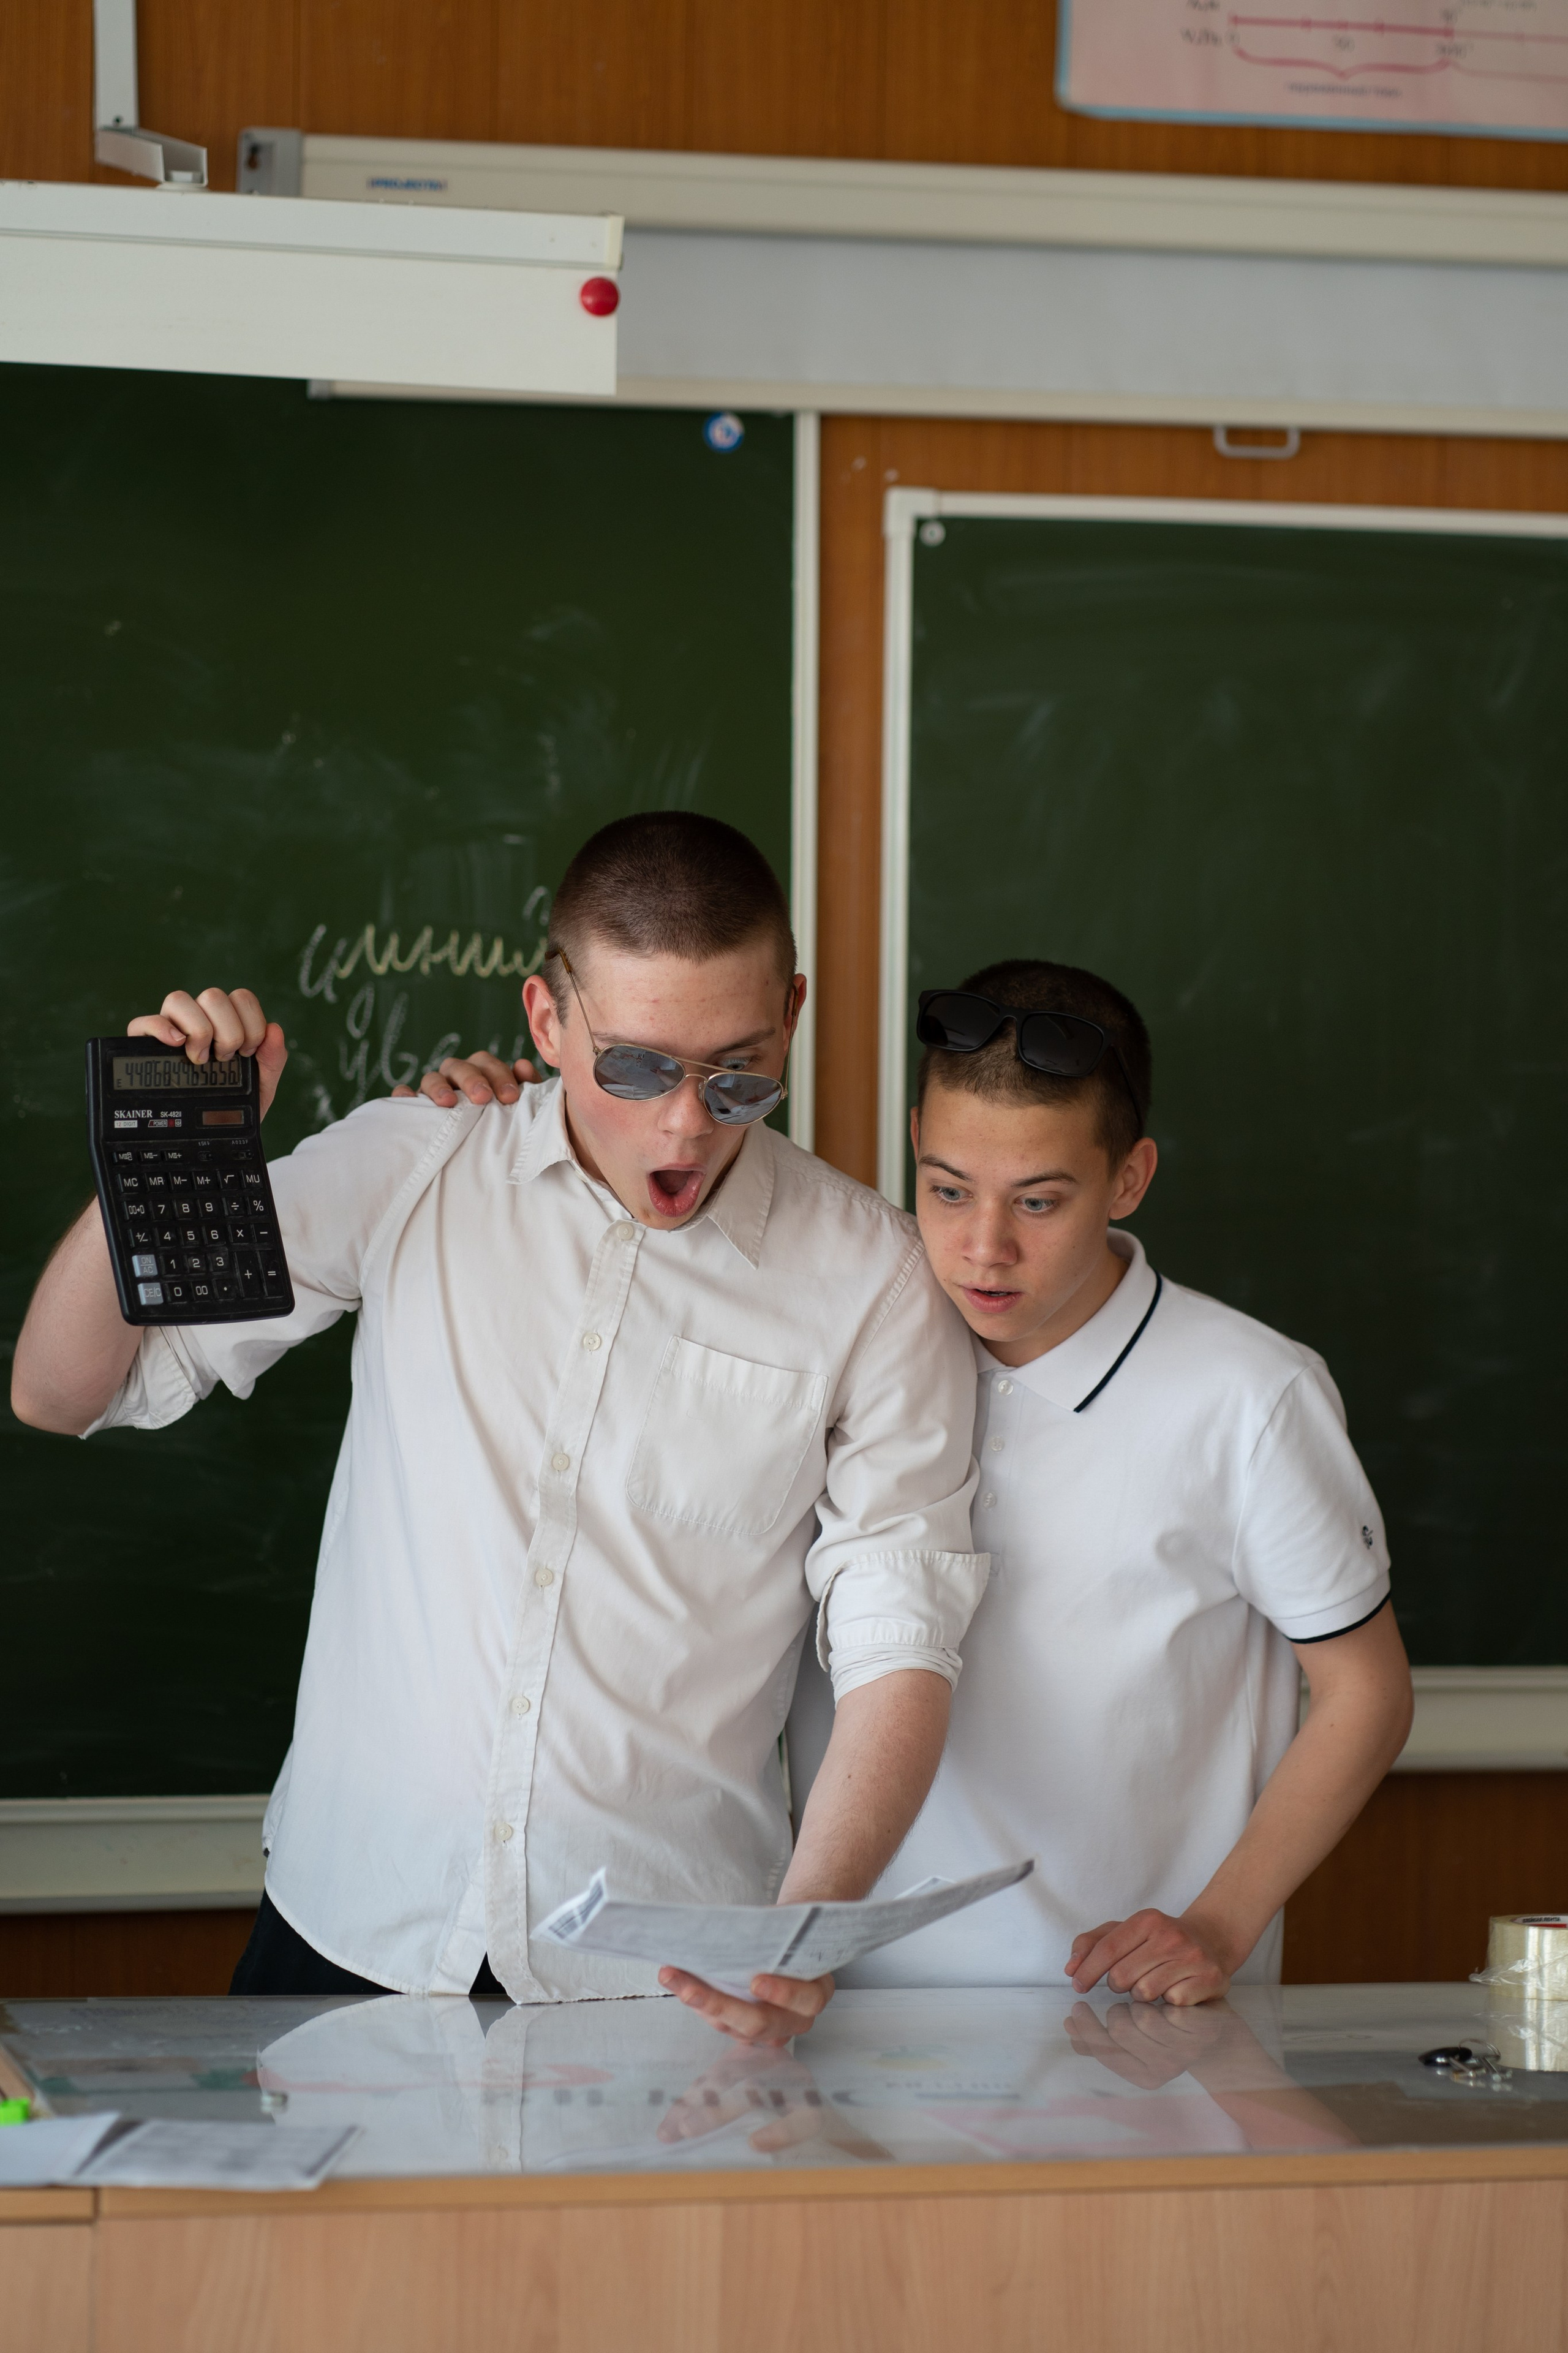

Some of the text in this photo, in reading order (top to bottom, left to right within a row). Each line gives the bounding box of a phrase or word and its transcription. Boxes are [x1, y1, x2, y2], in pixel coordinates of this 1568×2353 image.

[114, 1110, 153, 1119] SKAINER
[123, 1178, 138, 1187] MC
[149, 1177, 164, 1185] MR
[197, 1176, 211, 1185] M+
[246, 1174, 260, 1183] MU
[157, 1204, 165, 1214] 7
[182, 1204, 190, 1213] 8
[205, 1203, 213, 1212] 9
[253, 1200, 264, 1211] %
[164, 1231, 172, 1241] 4
[187, 1231, 195, 1240] 5
[211, 1230, 219, 1239] 6
[170, 1260, 176, 1269] 1
[192, 1258, 200, 1267] 2
[216, 1257, 224, 1266] 3
[174, 1287, 182, 1296] 0
[195, 1286, 208, 1295] 00
